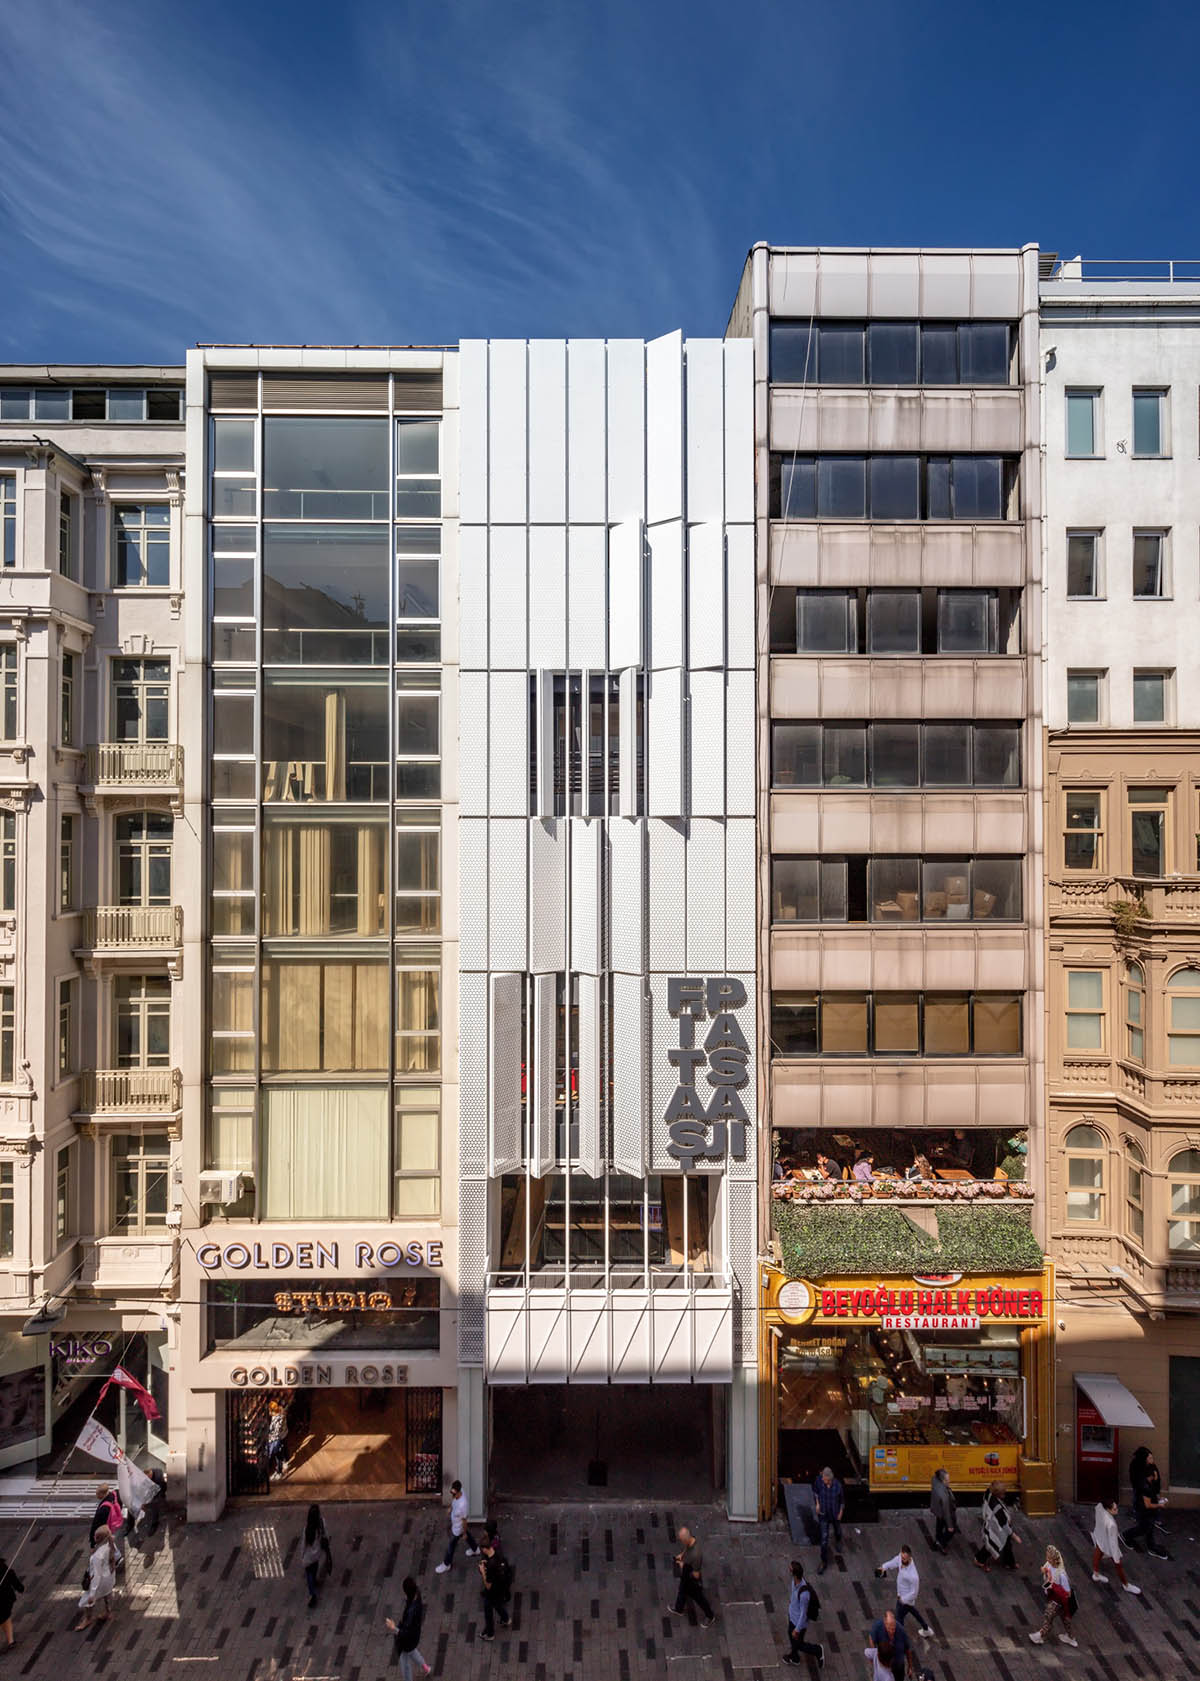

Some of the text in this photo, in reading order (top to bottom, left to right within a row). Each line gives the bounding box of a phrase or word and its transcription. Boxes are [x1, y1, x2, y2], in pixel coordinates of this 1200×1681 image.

[703, 978, 751, 1157] PASAJI
[196, 1240, 443, 1269] GOLDEN ROSE
[274, 1291, 392, 1312] STUDIO
[821, 1283, 913, 1316] BEYOĞLU
[918, 1289, 971, 1316] HALK
[977, 1285, 1043, 1316] DÖNER
[885, 1317, 978, 1328] RESTAURANT
[49, 1340, 112, 1357] KIKO
[230, 1364, 409, 1386] GOLDEN ROSE
